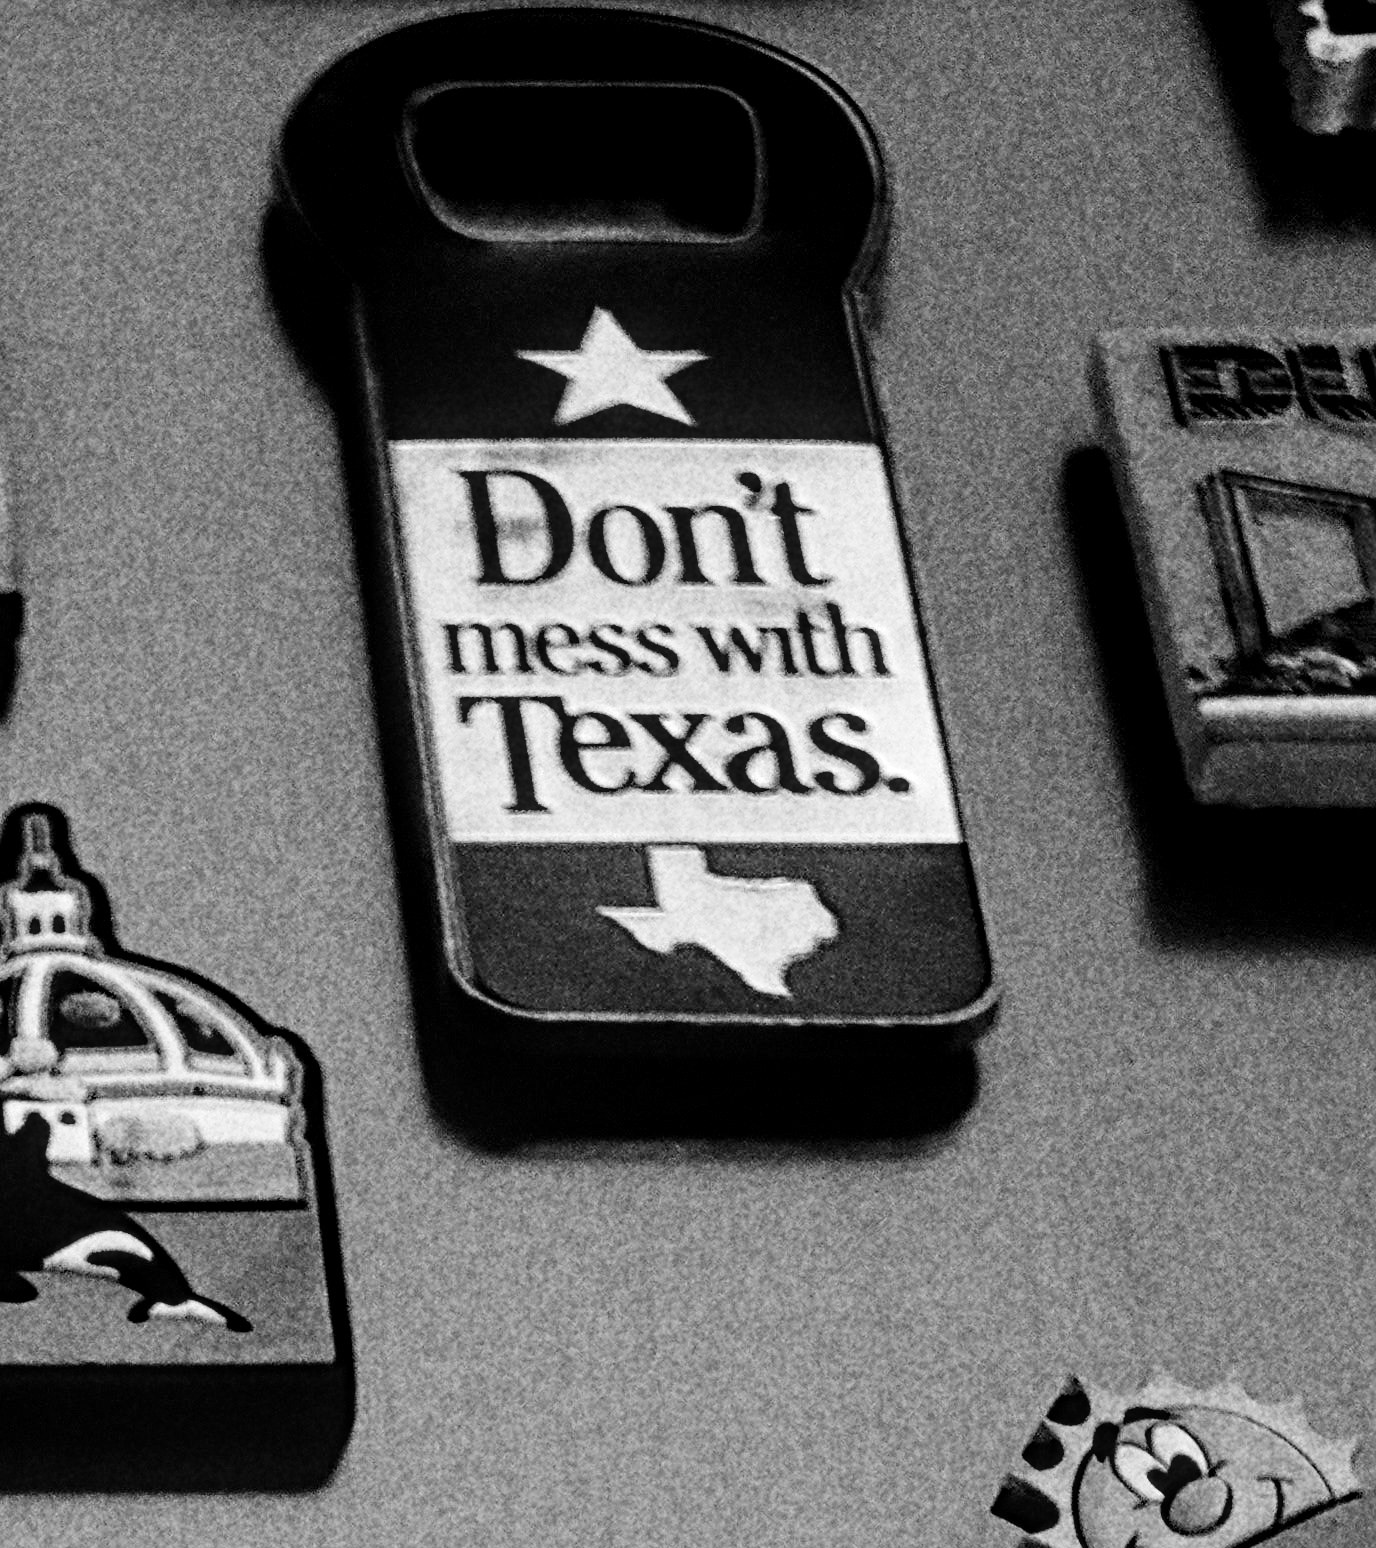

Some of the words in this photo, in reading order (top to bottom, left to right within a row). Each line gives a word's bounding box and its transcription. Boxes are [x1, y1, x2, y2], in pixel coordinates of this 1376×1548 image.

[454, 469, 832, 588] Don't
[444, 619, 680, 678] mess
[695, 604, 893, 680] with
[459, 693, 911, 815] Texas.
